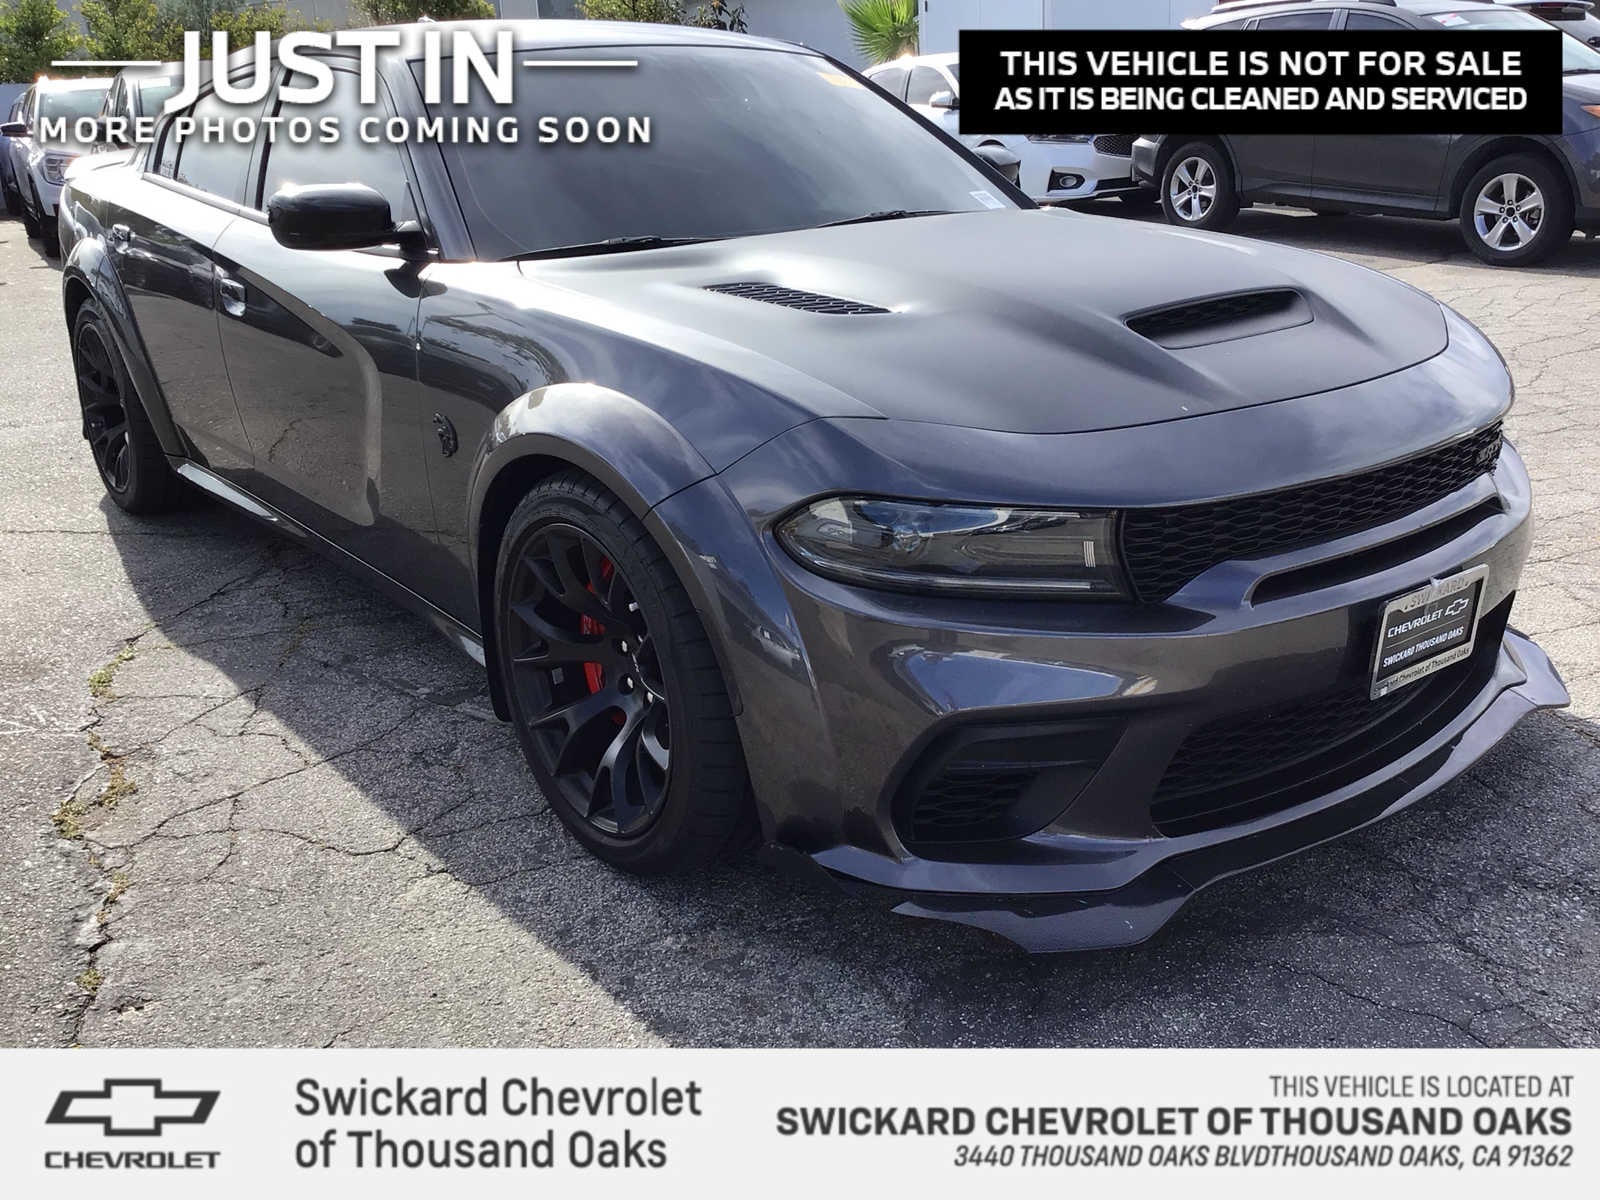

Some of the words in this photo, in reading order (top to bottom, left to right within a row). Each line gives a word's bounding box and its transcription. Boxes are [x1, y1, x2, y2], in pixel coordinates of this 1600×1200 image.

[1387, 608, 1444, 638] CHEVROLET
[1383, 646, 1415, 668] SWICKARD
[1415, 632, 1448, 654] THOUSAND
[1447, 626, 1464, 640] OAKS
